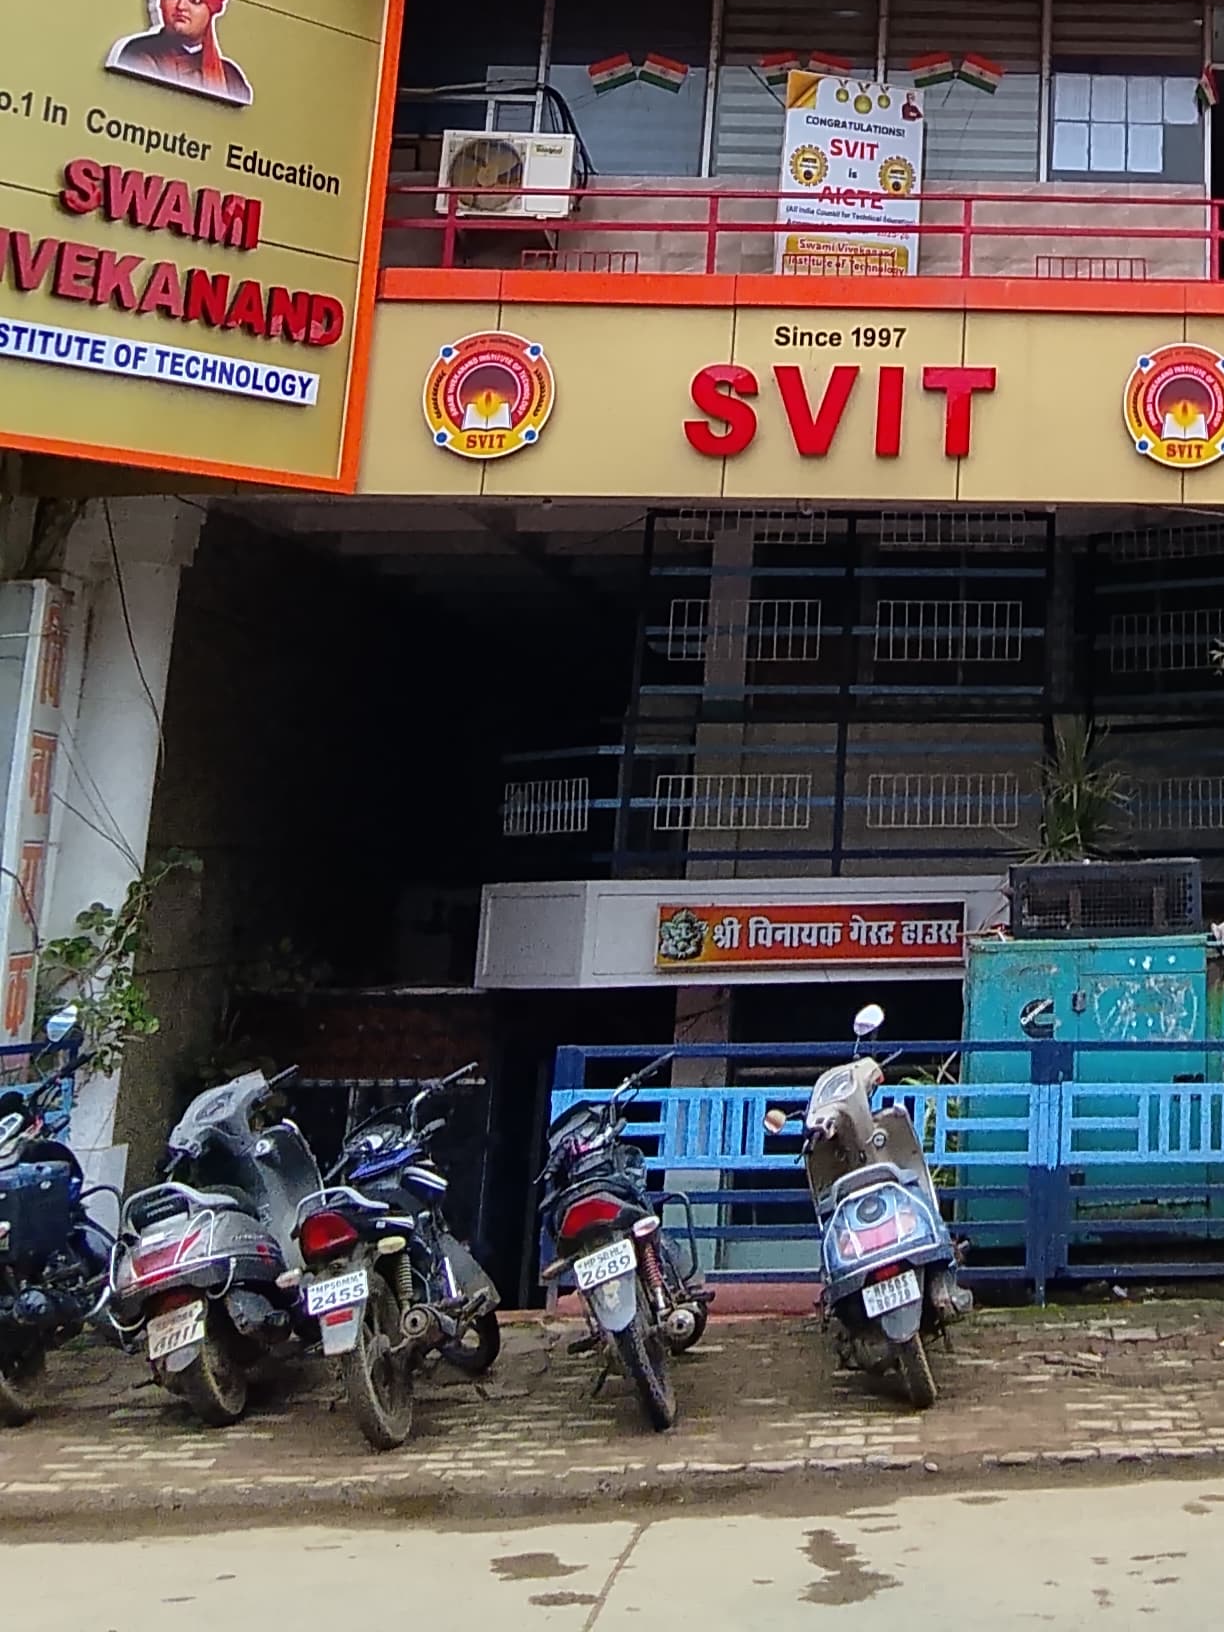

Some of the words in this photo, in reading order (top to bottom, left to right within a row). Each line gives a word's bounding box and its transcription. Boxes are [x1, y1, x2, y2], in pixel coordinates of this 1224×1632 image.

[806, 115, 906, 138] CONGRATULATIONS!
[0, 91, 33, 118] o.1
[86, 108, 211, 162] Computer
[226, 144, 341, 196] Education
[830, 138, 879, 161] SVIT
[59, 158, 262, 251] SWAMI
[818, 185, 884, 210] AICTE
[0, 228, 345, 346] IVEKANAND
[774, 325, 842, 348] Since
[850, 326, 907, 348] 1997
[0, 322, 107, 364] STITUTE
[113, 342, 148, 370] OF
[155, 349, 314, 400] TECHNOLOGY
[684, 363, 996, 458] SVIT
[466, 433, 506, 450] SVIT
[1166, 443, 1204, 459] SVIT
[749, 916, 841, 948] विनायक
[582, 1255, 631, 1287] 2689
[311, 1283, 365, 1312] 2455
